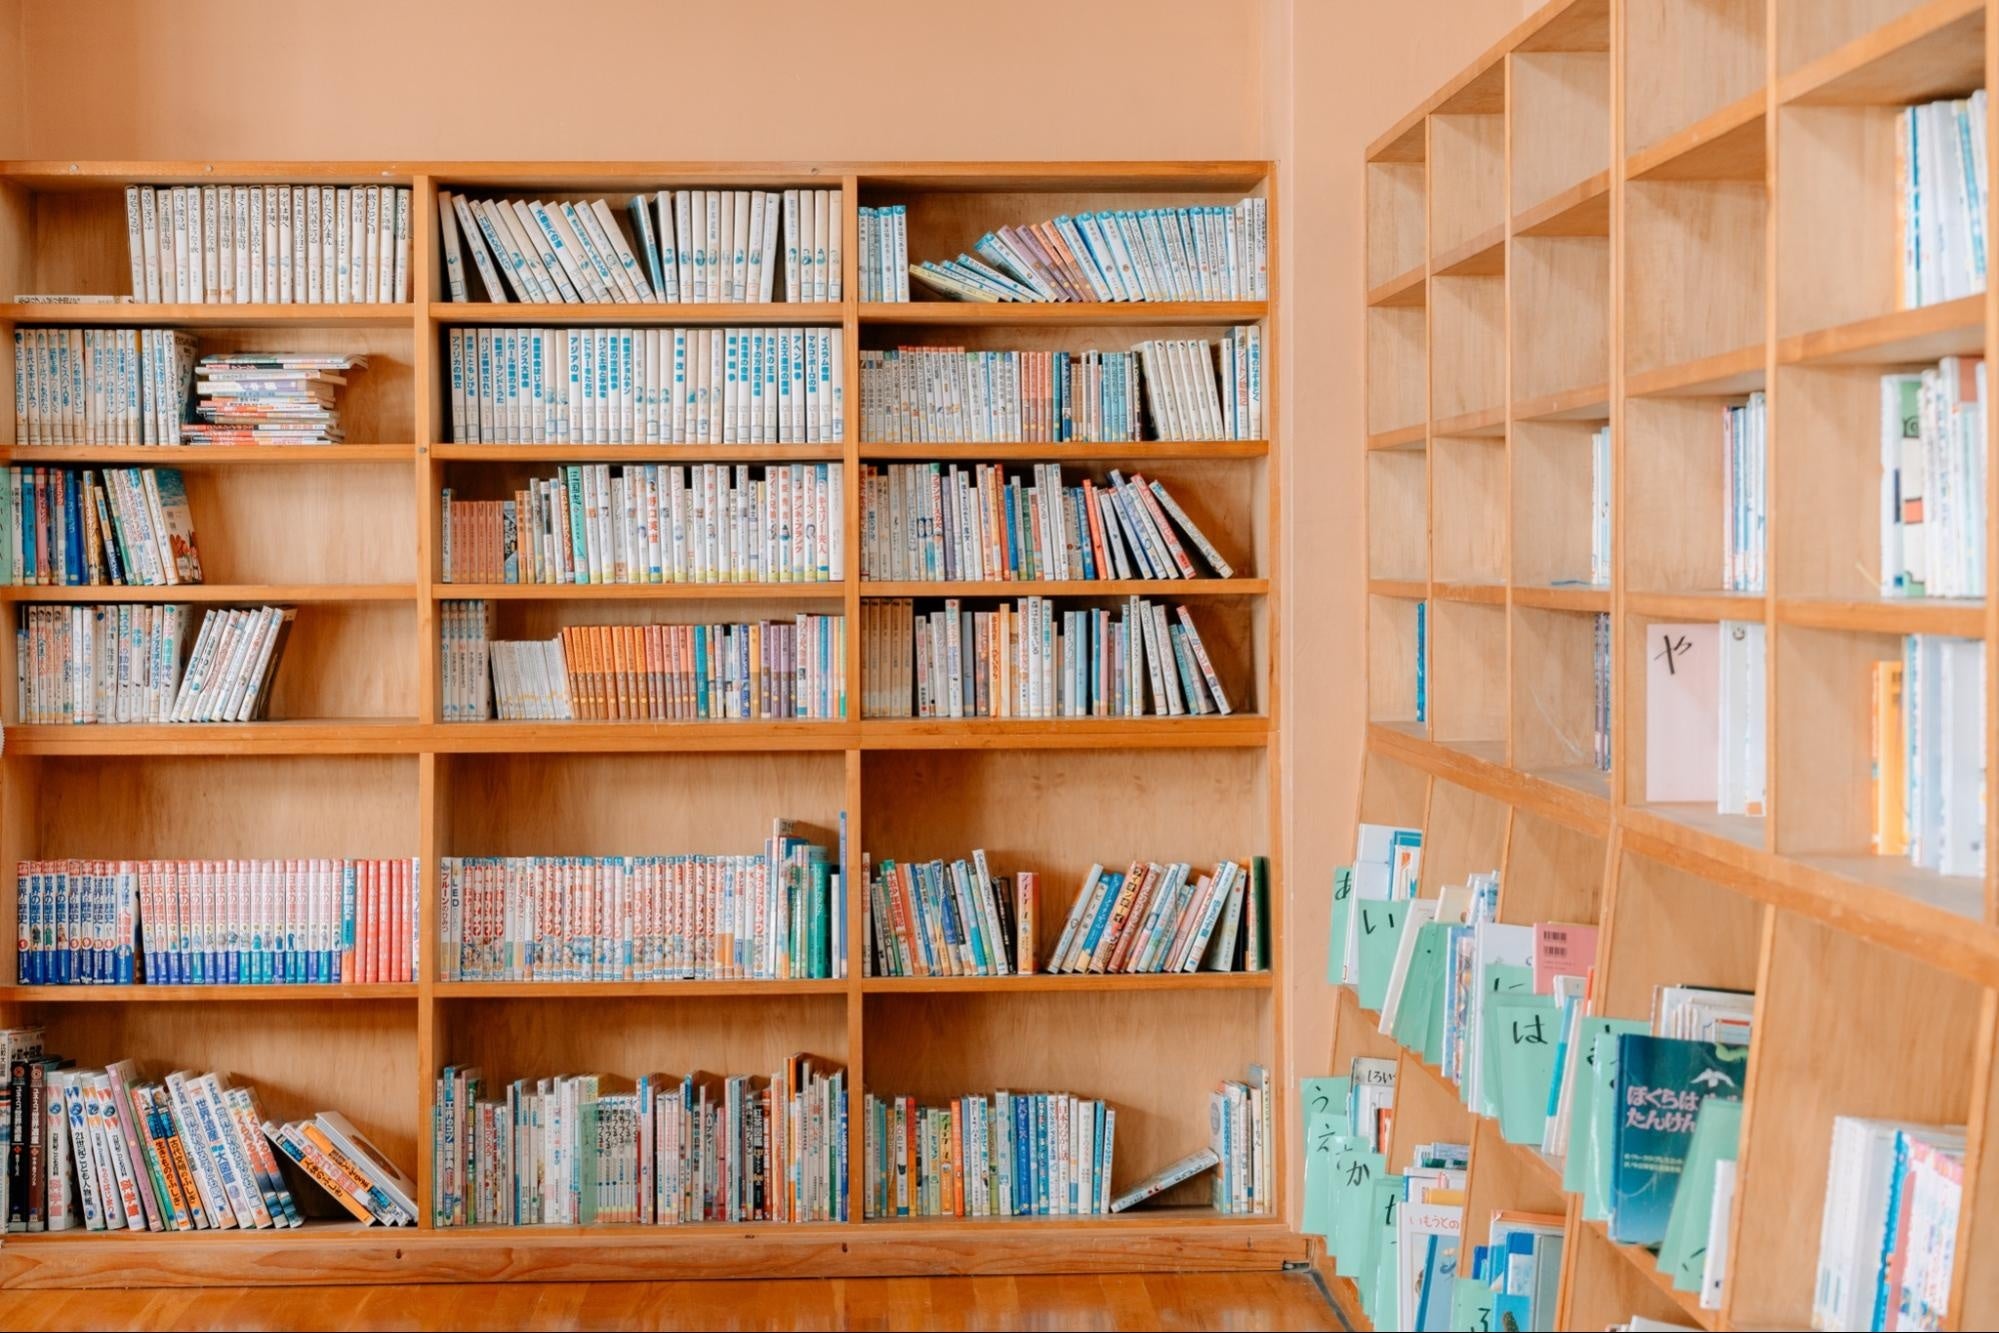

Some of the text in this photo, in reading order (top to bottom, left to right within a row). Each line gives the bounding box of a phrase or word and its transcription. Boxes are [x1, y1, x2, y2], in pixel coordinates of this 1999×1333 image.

[571, 471, 582, 505] 三国志
[1654, 633, 1693, 675] や
[19, 877, 28, 925] 世界の歴史
[32, 875, 41, 924] 世界の歴史
[45, 875, 54, 924] 世界の歴史
[57, 875, 66, 924] 世界の歴史
[69, 877, 79, 924] 世界の歴史
[82, 876, 92, 924] 世界の歴史
[94, 877, 104, 924] 世界の歴史
[105, 877, 114, 924] 世界の歴史
[1364, 909, 1394, 935] い
[1513, 1015, 1548, 1044] は
[1312, 1086, 1329, 1112] う
[1346, 1160, 1370, 1186] か
[1410, 1215, 1459, 1230] いもうとの
